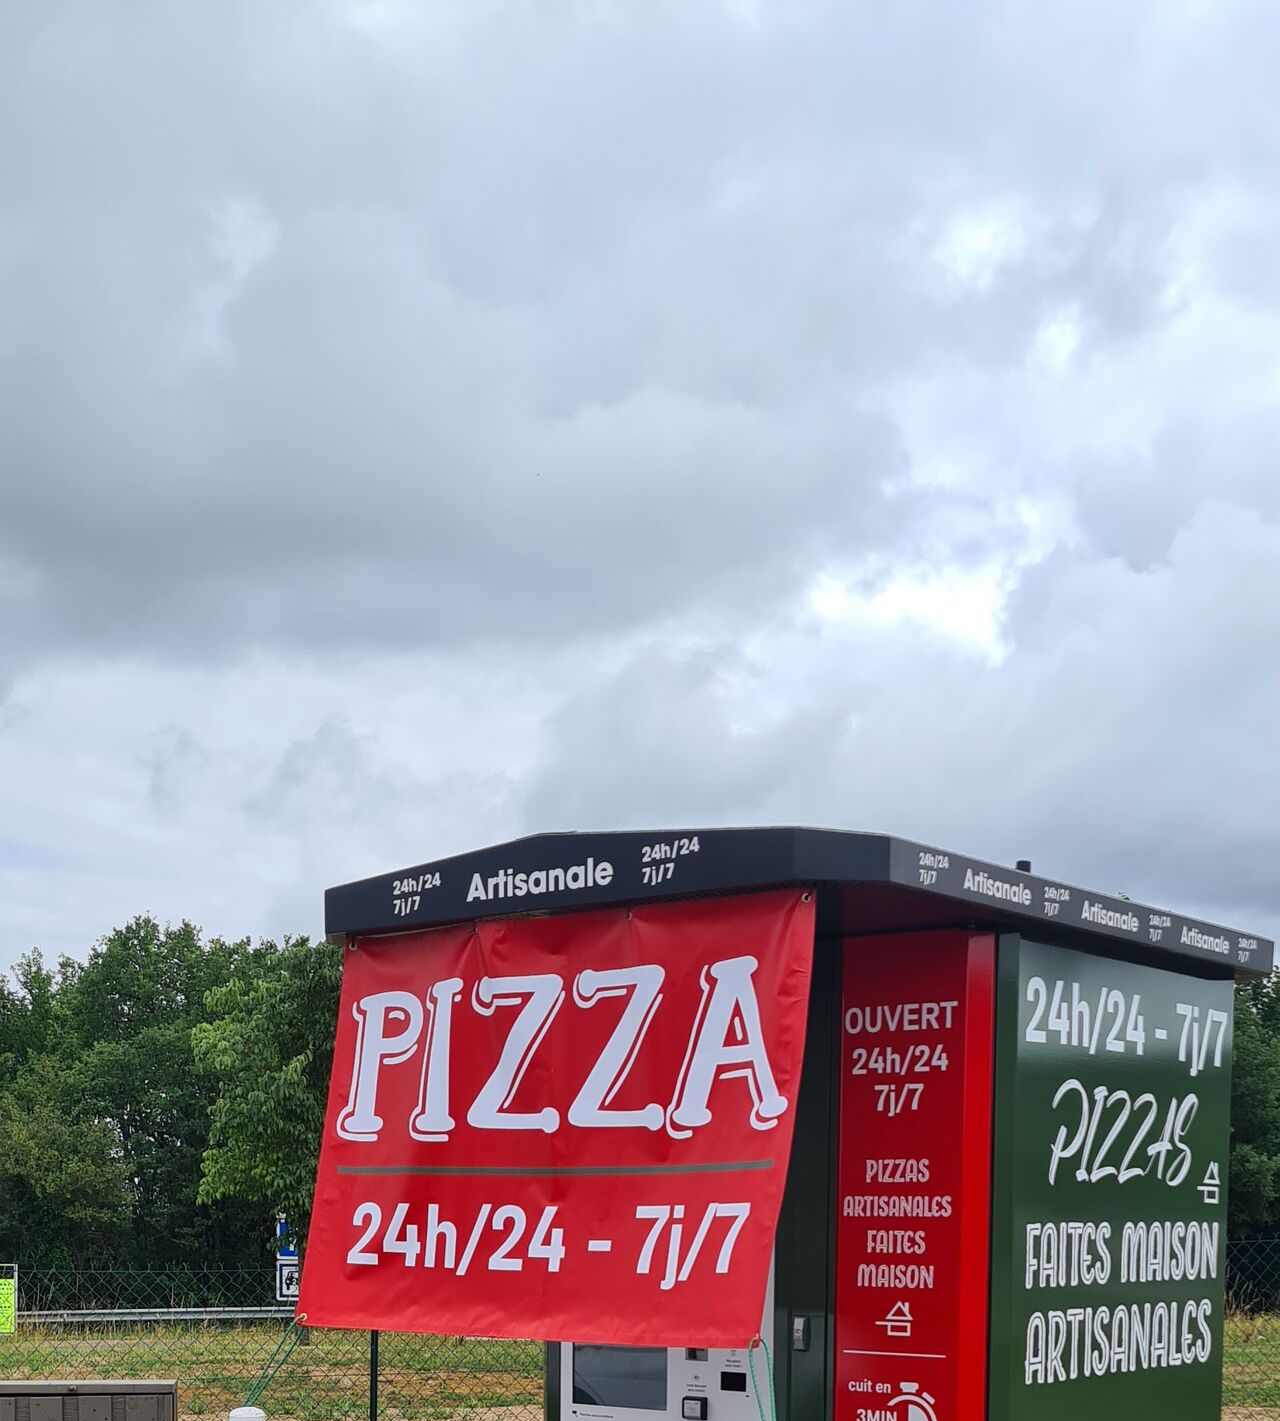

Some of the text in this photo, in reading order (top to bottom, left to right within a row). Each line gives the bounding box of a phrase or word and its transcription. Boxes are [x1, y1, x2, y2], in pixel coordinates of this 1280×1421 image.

[641, 836, 699, 863] 24h/24
[918, 851, 949, 870] 24h/24
[392, 871, 441, 895] 24h/24
[466, 857, 614, 902] Artisanale
[641, 862, 675, 885] 7j/7
[919, 869, 937, 886] 7j/7
[963, 868, 1032, 905] Artisanale
[393, 896, 421, 916] 7j/7
[1043, 886, 1070, 901] 24h/24
[1043, 902, 1060, 916] 7j/7
[1081, 900, 1139, 932] Artisanale
[1180, 925, 1230, 955] Artisanale
[845, 1001, 958, 1035] OUVERT
[1025, 976, 1228, 1077] 24h/24 - 7j/7
[336, 955, 789, 1142] PIZZA
[851, 1044, 949, 1075] 24h/24
[874, 1083, 924, 1117] 7j/7
[1048, 1078, 1199, 1187] PIZZAS
[865, 1158, 930, 1183] PIZZAS
[843, 1195, 952, 1217] ARTISANALES
[347, 1202, 751, 1290] 24h/24 - 7j/7
[867, 1230, 926, 1254] FAITES
[1025, 1221, 1219, 1290] FAITES MAISON
[857, 1264, 934, 1288] MAISON
[1024, 1298, 1212, 1385] ARTISANALES
[848, 1379, 891, 1394] cuit en
